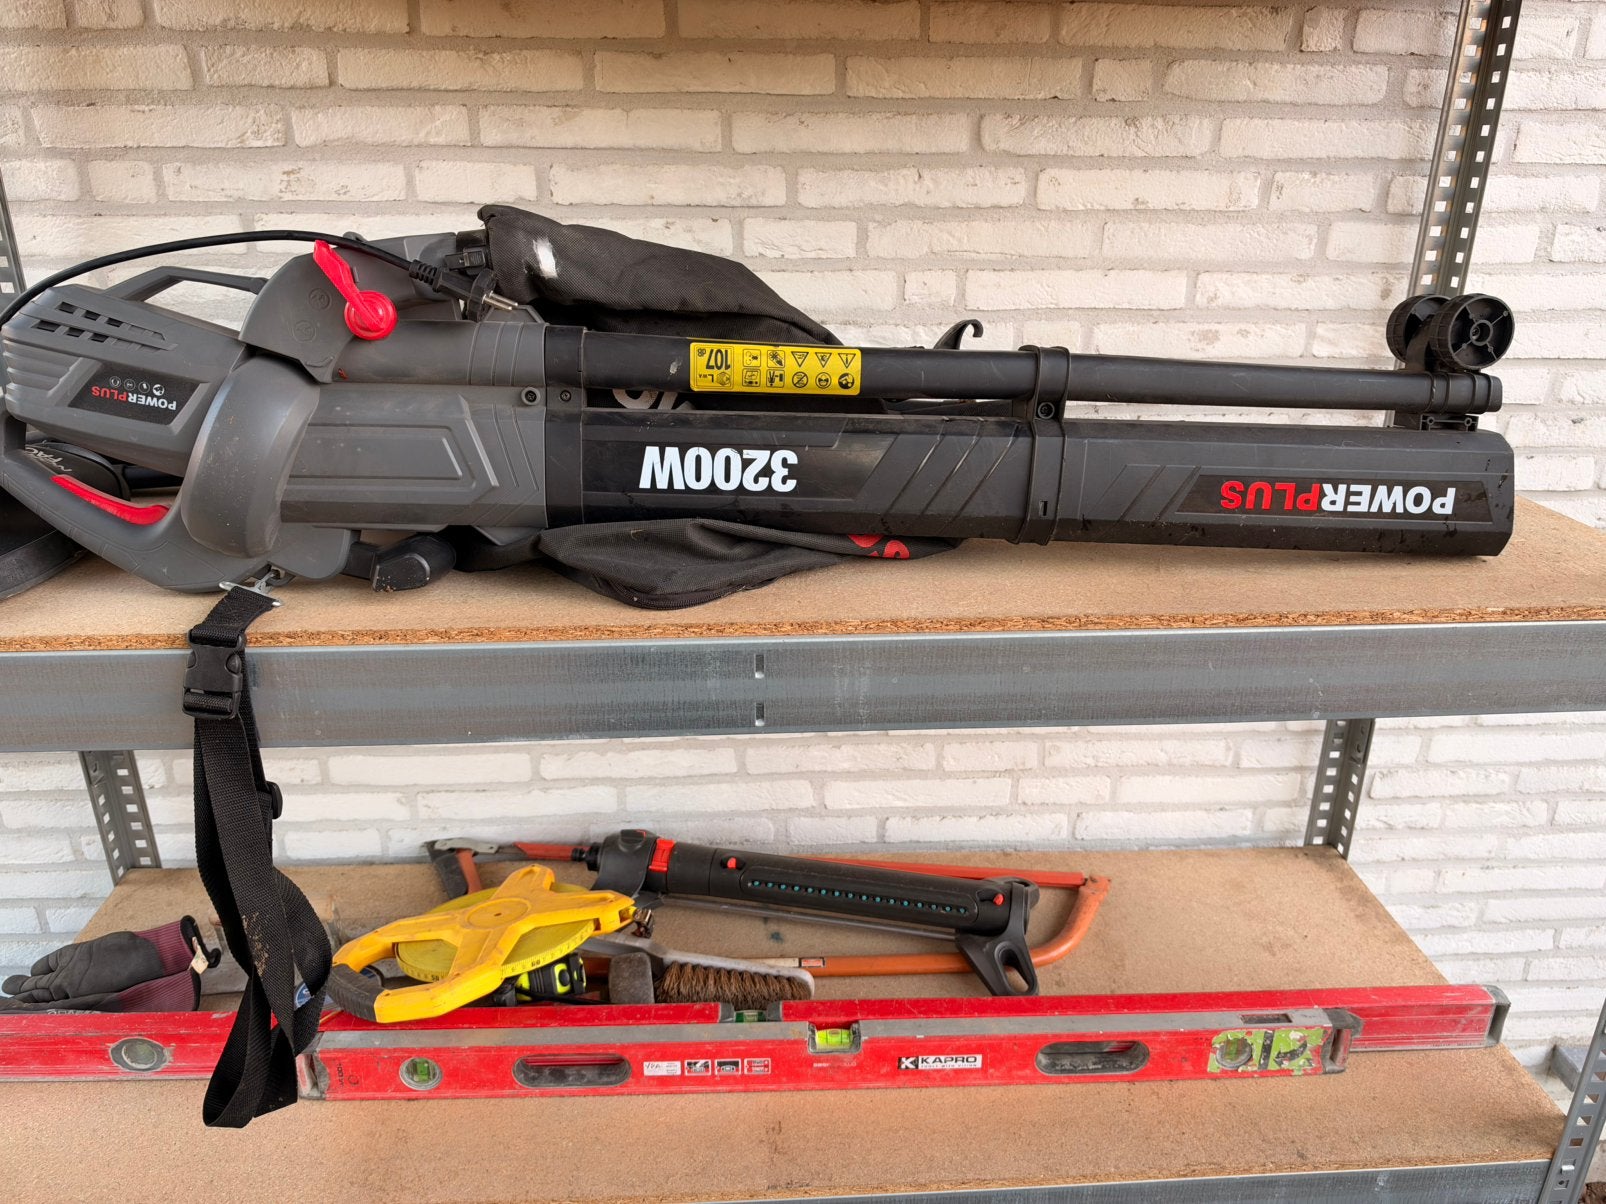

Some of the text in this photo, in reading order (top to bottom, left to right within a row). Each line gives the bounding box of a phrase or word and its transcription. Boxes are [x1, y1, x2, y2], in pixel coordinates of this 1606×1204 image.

[705, 348, 731, 371] 107
[91, 385, 177, 411] POWERPLUS
[638, 445, 799, 493] 3200W
[1220, 480, 1457, 515] POWERPLUS
[921, 1055, 977, 1064] KAPRO
